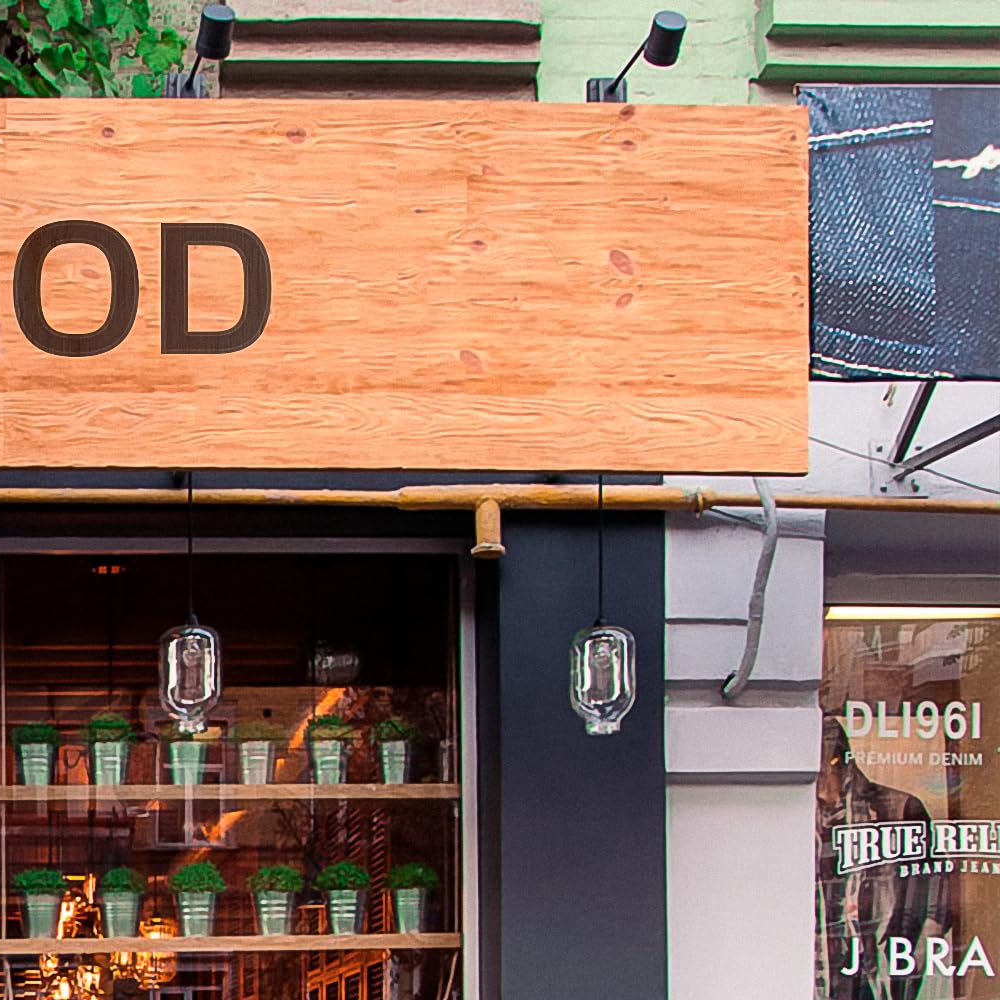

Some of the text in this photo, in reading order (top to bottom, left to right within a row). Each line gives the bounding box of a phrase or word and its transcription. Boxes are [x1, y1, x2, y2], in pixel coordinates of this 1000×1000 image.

[845, 751, 983, 766] PREMIUM DENIM
[836, 823, 1000, 869] TRUE REL
[900, 861, 954, 877] BRAND
[841, 936, 995, 976] J BRA
